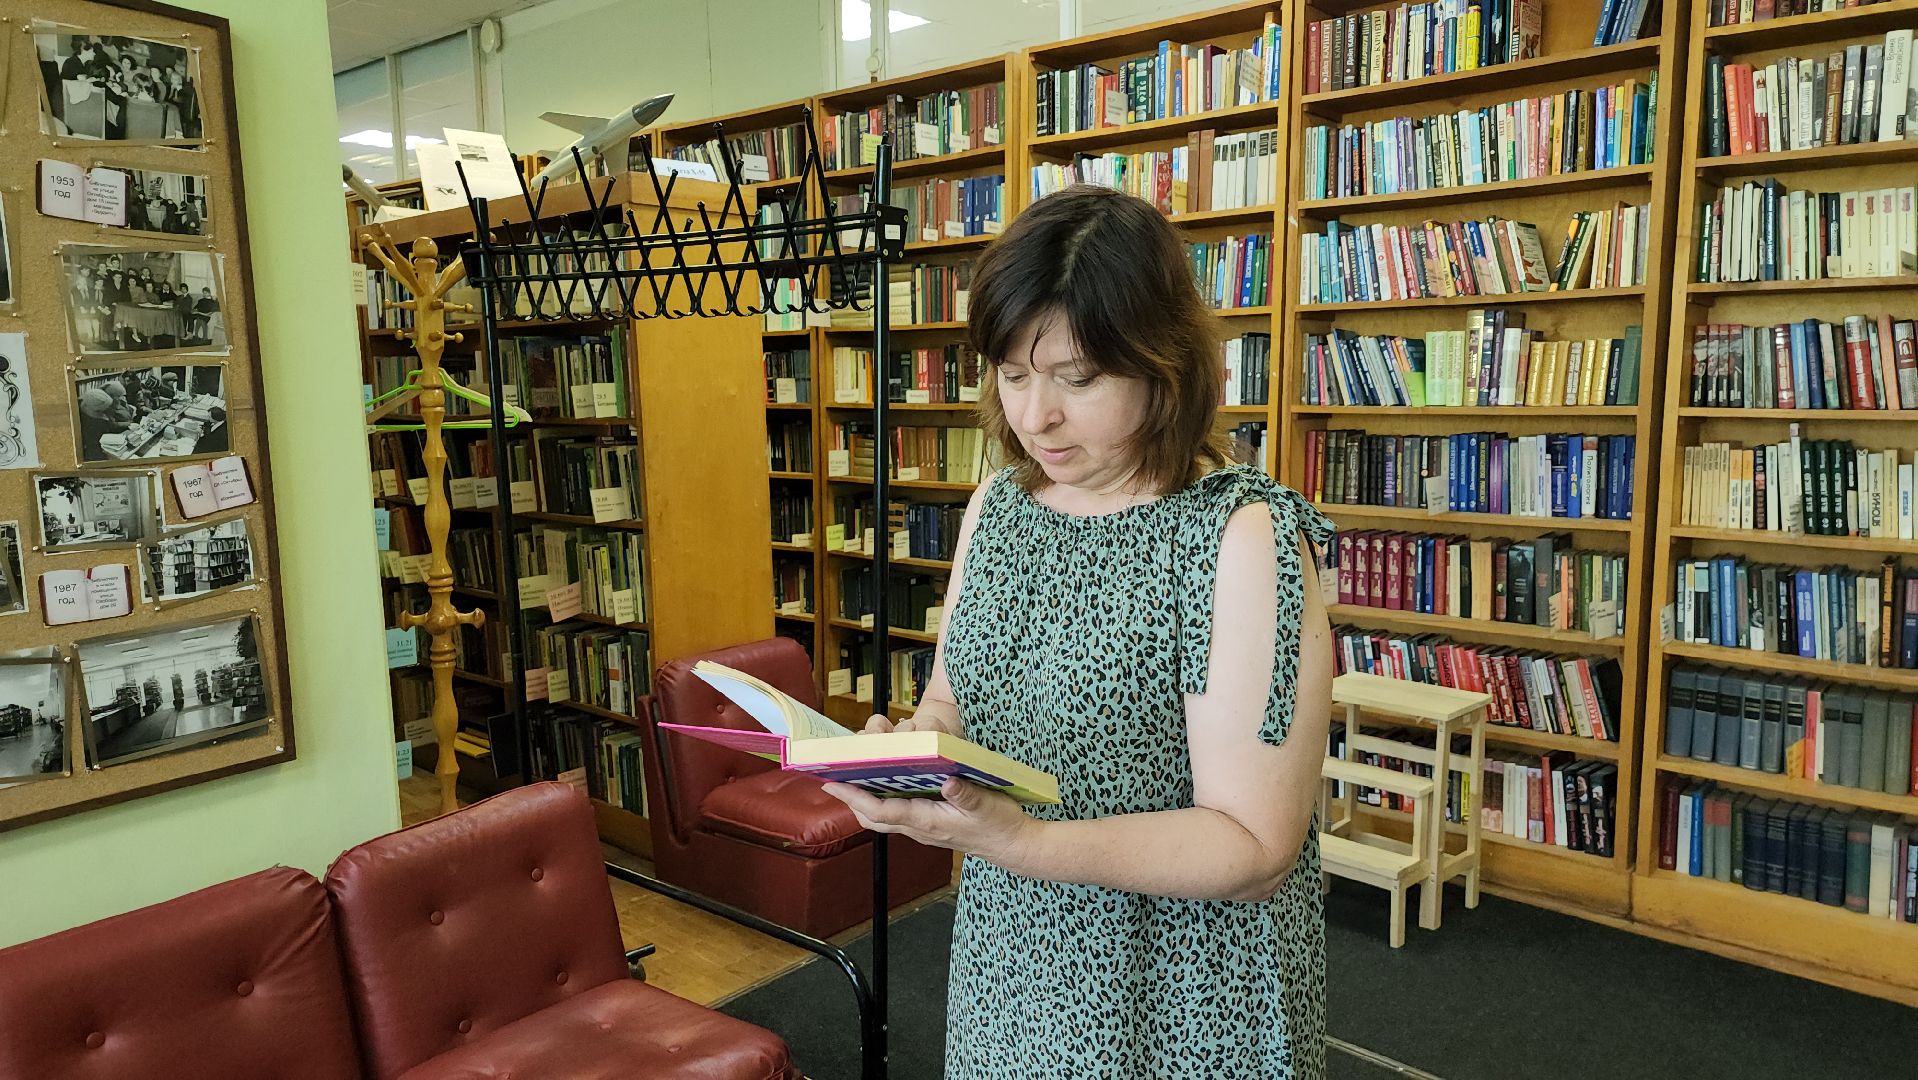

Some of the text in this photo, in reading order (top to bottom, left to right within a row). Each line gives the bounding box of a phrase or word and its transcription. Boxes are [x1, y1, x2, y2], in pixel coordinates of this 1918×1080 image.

[1347, 17, 1355, 48] КАРНЕГИ
[1886, 38, 1896, 61] Время
[1892, 36, 1905, 84] Березовского
[50, 175, 75, 187] 1953
[54, 189, 71, 199] год
[183, 477, 202, 489] 1967
[1585, 455, 1594, 505] Политология
[189, 490, 204, 499] год
[1872, 492, 1881, 527] ЯПОНИЯ
[1807, 517, 1813, 528] 1
[1821, 518, 1829, 528] 2
[1835, 518, 1843, 528] 3
[54, 583, 77, 593] 1987
[58, 597, 76, 605] год
